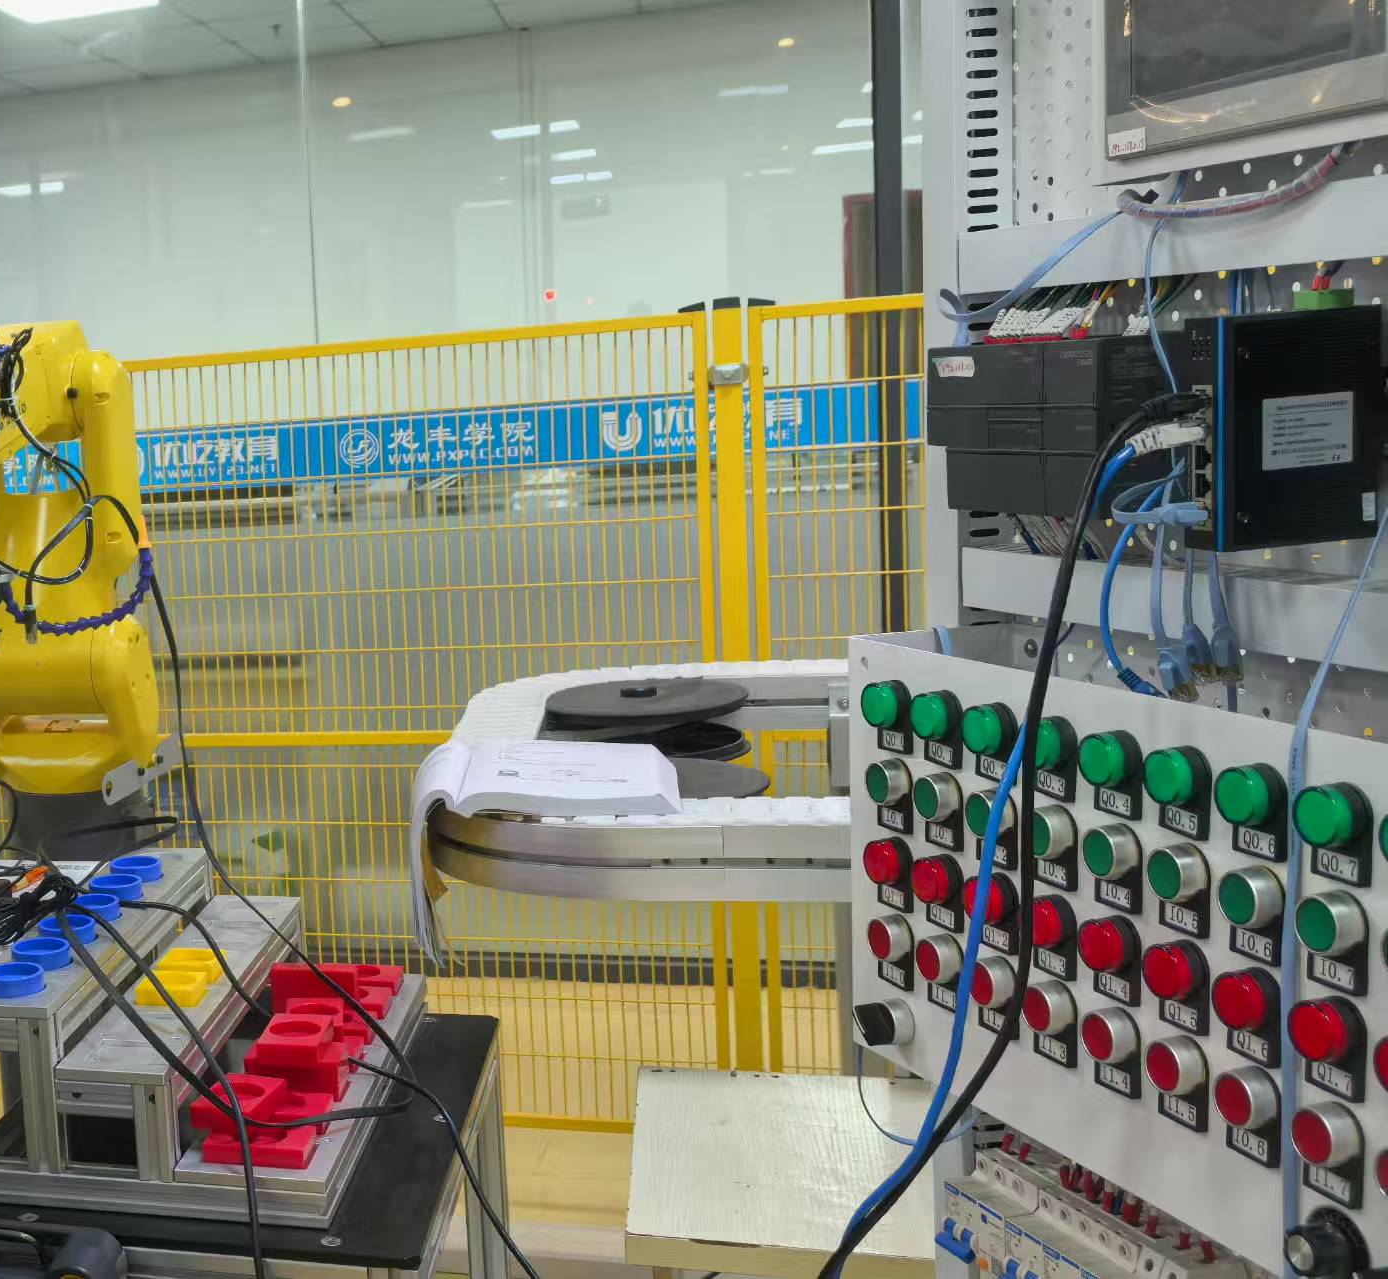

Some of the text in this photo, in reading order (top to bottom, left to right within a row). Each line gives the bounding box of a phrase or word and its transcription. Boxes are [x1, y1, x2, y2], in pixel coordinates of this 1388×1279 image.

[387, 421, 535, 450] 龙丰学院
[152, 436, 277, 467] 优屹教育
[930, 743, 953, 763] Q0.1
[1038, 771, 1066, 793] Q0.3
[1101, 790, 1130, 812] Q0.4
[1166, 807, 1197, 831] Q0.5
[934, 824, 955, 844] I0.
[1243, 830, 1276, 854] Q0.6
[1320, 852, 1358, 877] Q0.7
[1104, 880, 1131, 904] I0.4
[1170, 904, 1198, 930] I0.5
[983, 924, 1008, 947] Q1.2
[1240, 931, 1272, 958] I0.6
[1040, 950, 1066, 974] Q1.3
[1318, 957, 1355, 986] I0.7
[1099, 973, 1129, 998] Q1.4
[1168, 1003, 1197, 1028] Q1.5
[1102, 1064, 1129, 1090] I1.4
[1317, 1062, 1353, 1092] Q1.7
[1166, 1094, 1196, 1122] I1.5
[1234, 1128, 1266, 1156] I0.6
[1313, 1167, 1349, 1196] I1.7
